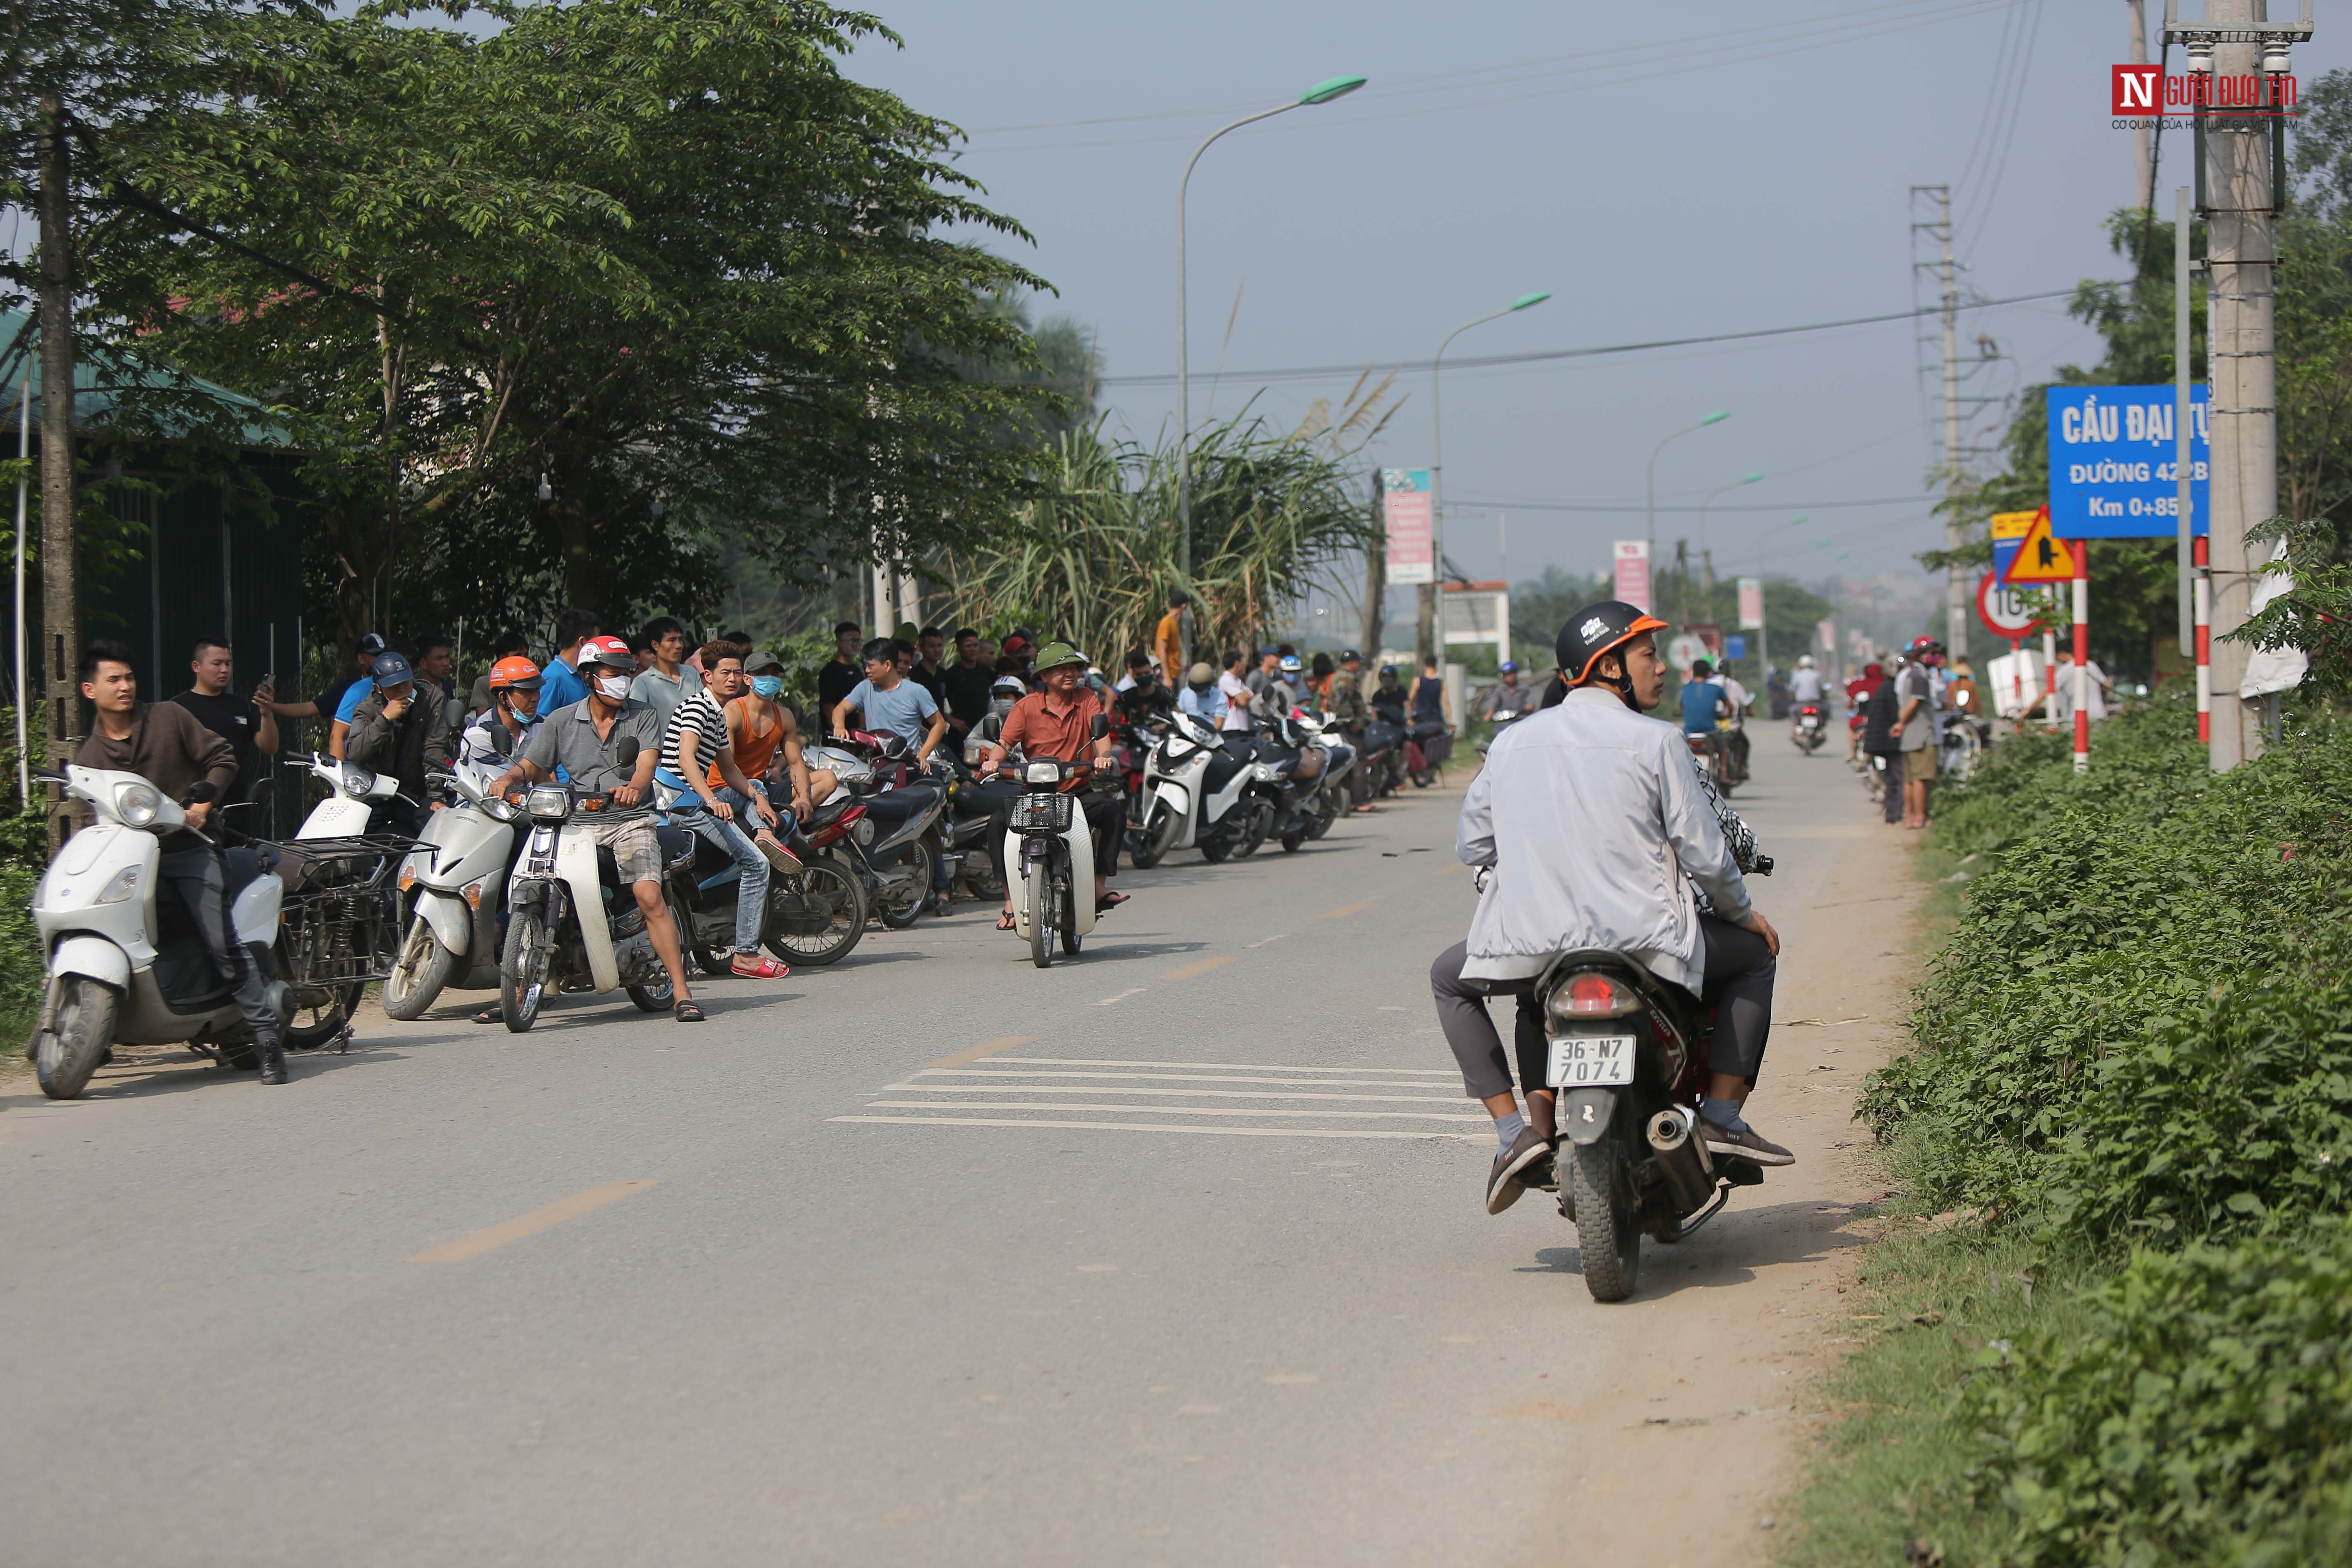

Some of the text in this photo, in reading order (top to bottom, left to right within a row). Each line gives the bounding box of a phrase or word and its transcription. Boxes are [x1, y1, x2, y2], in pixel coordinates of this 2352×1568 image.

[2125, 404, 2173, 447] ĐẠI
[2069, 457, 2151, 484] ĐƯỜNG
[2088, 497, 2193, 517] Km 0+85
[1650, 1010, 1671, 1037] EXCITER
[1562, 1039, 1622, 1060] 36-N7
[1560, 1061, 1620, 1082] 7074
